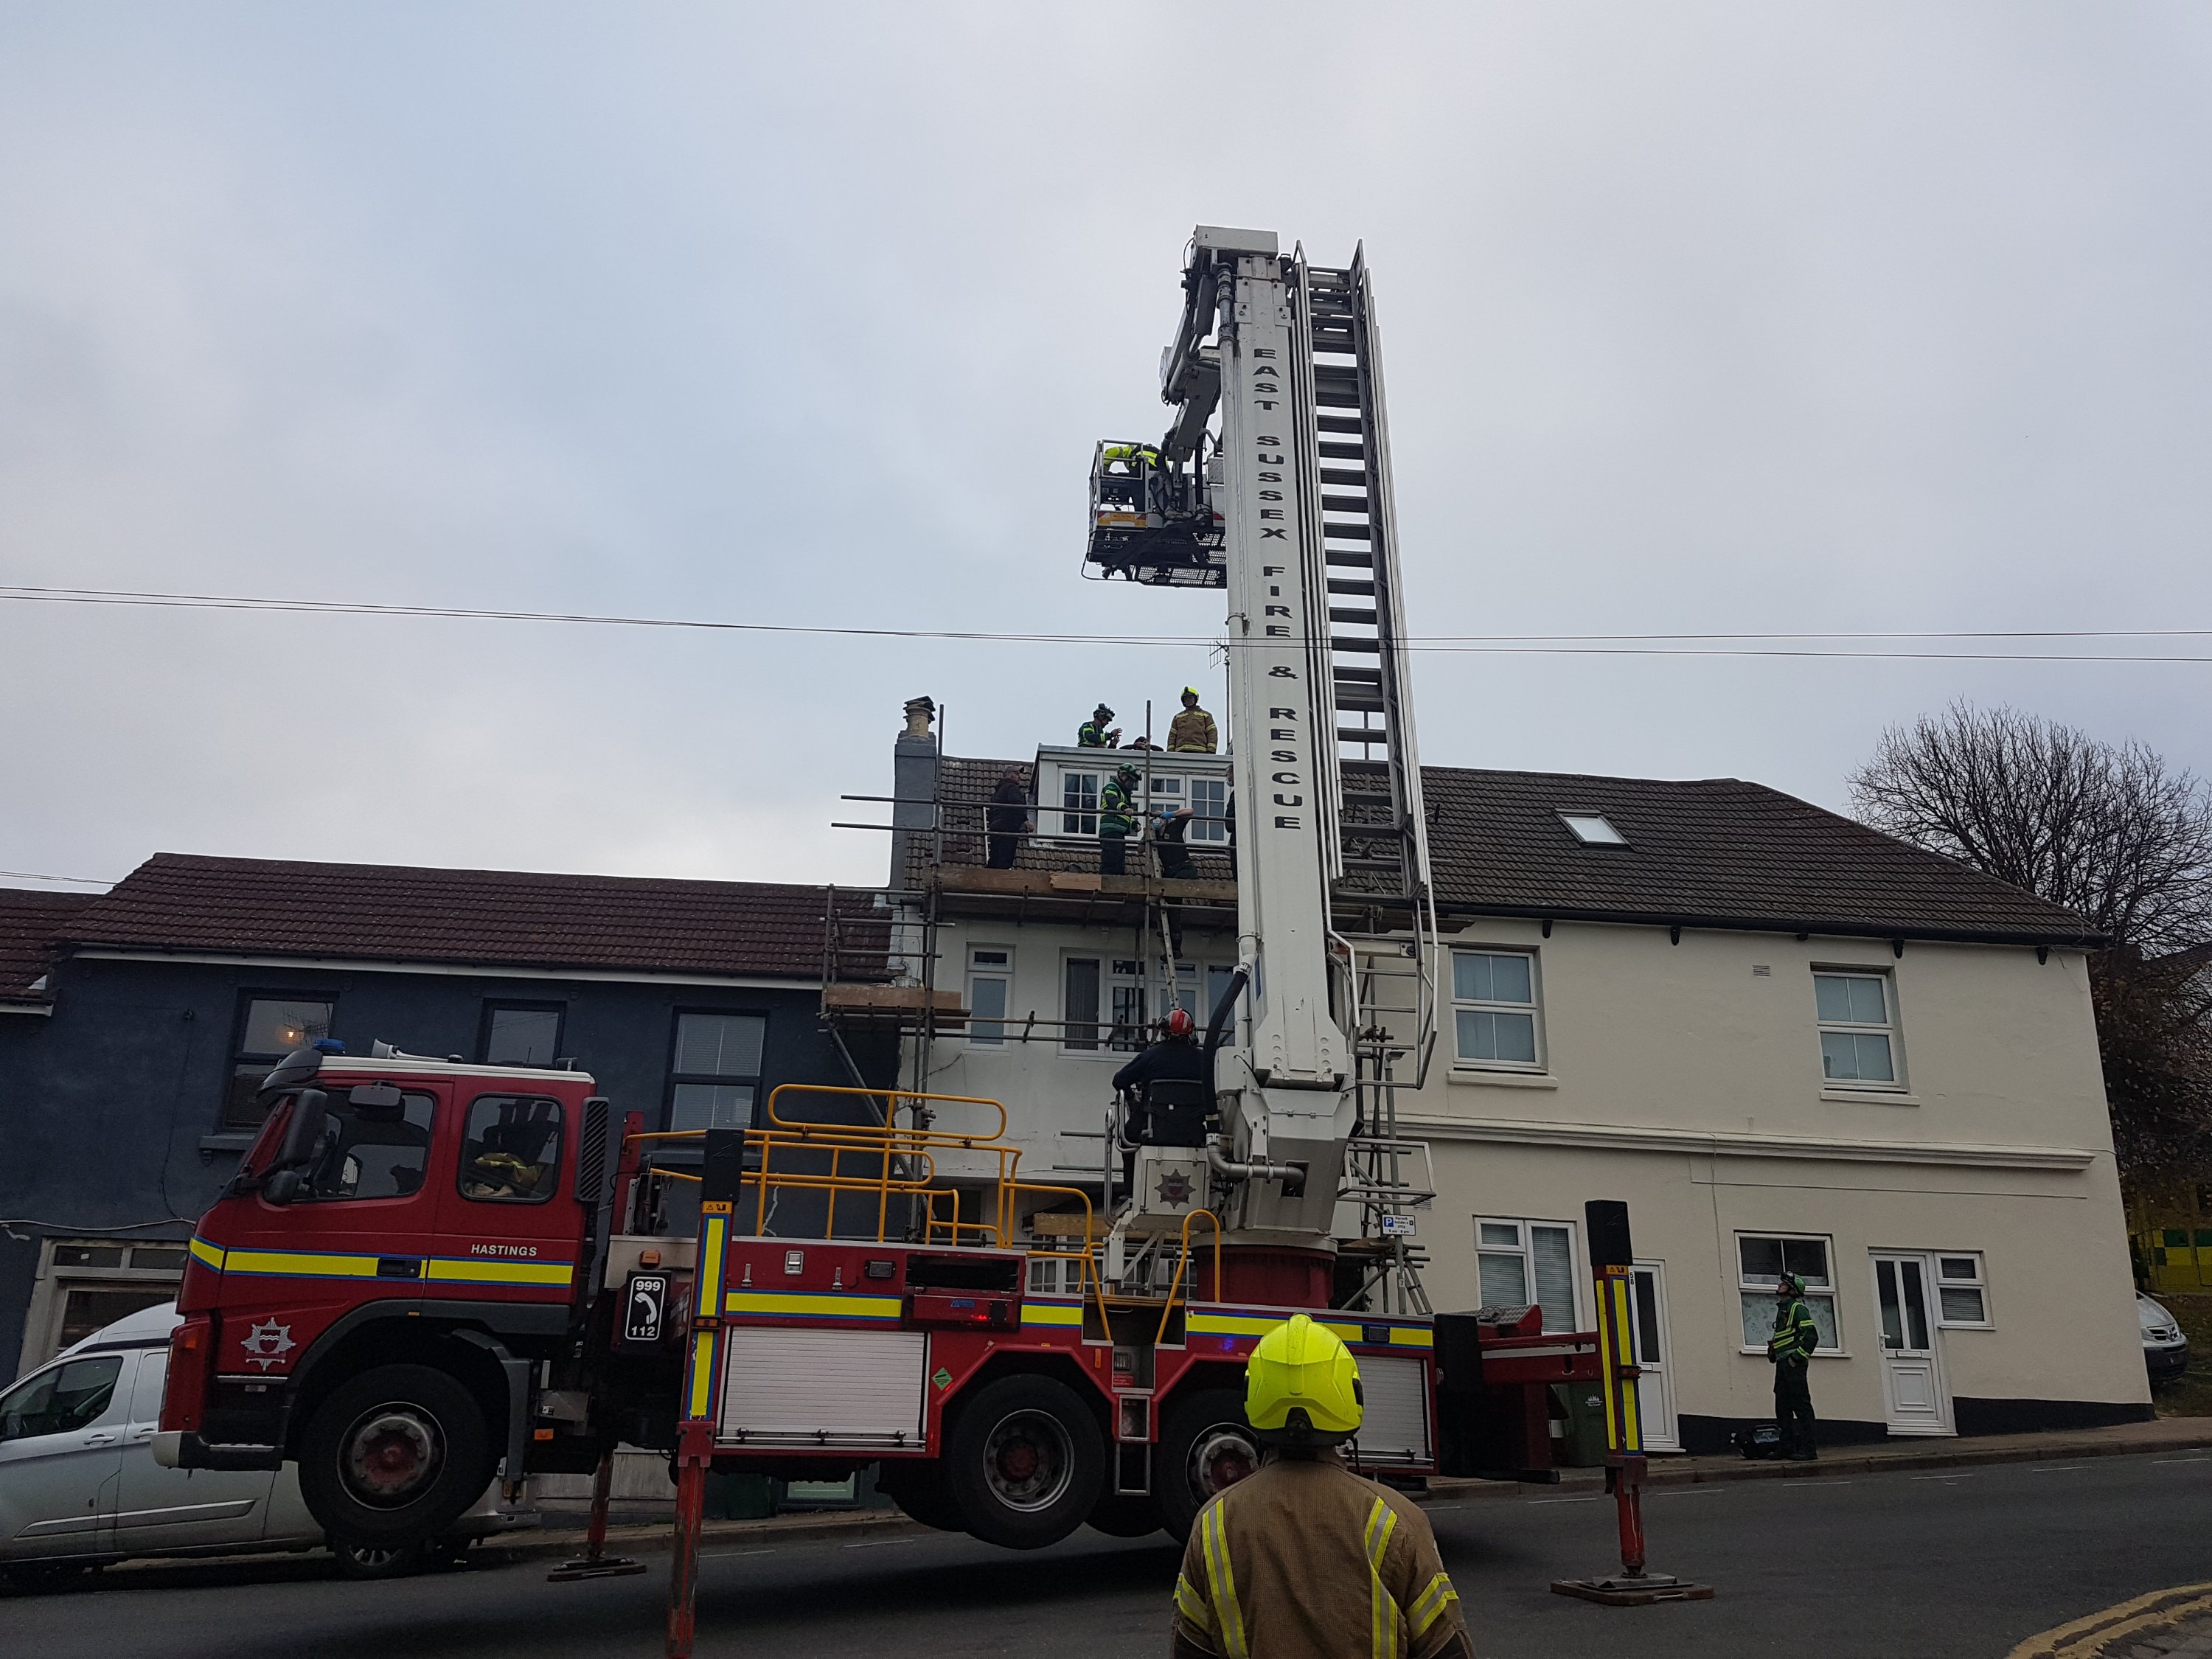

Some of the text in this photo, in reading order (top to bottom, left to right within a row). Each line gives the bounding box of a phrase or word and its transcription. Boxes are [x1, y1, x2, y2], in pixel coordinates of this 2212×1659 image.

[1253, 348, 1303, 830] EAST SUSSEX FIRE & RESCUE
[1385, 1217, 1392, 1226] P
[471, 1244, 538, 1256] HASTINGS
[636, 1280, 661, 1291] 999
[631, 1326, 655, 1336] 112
